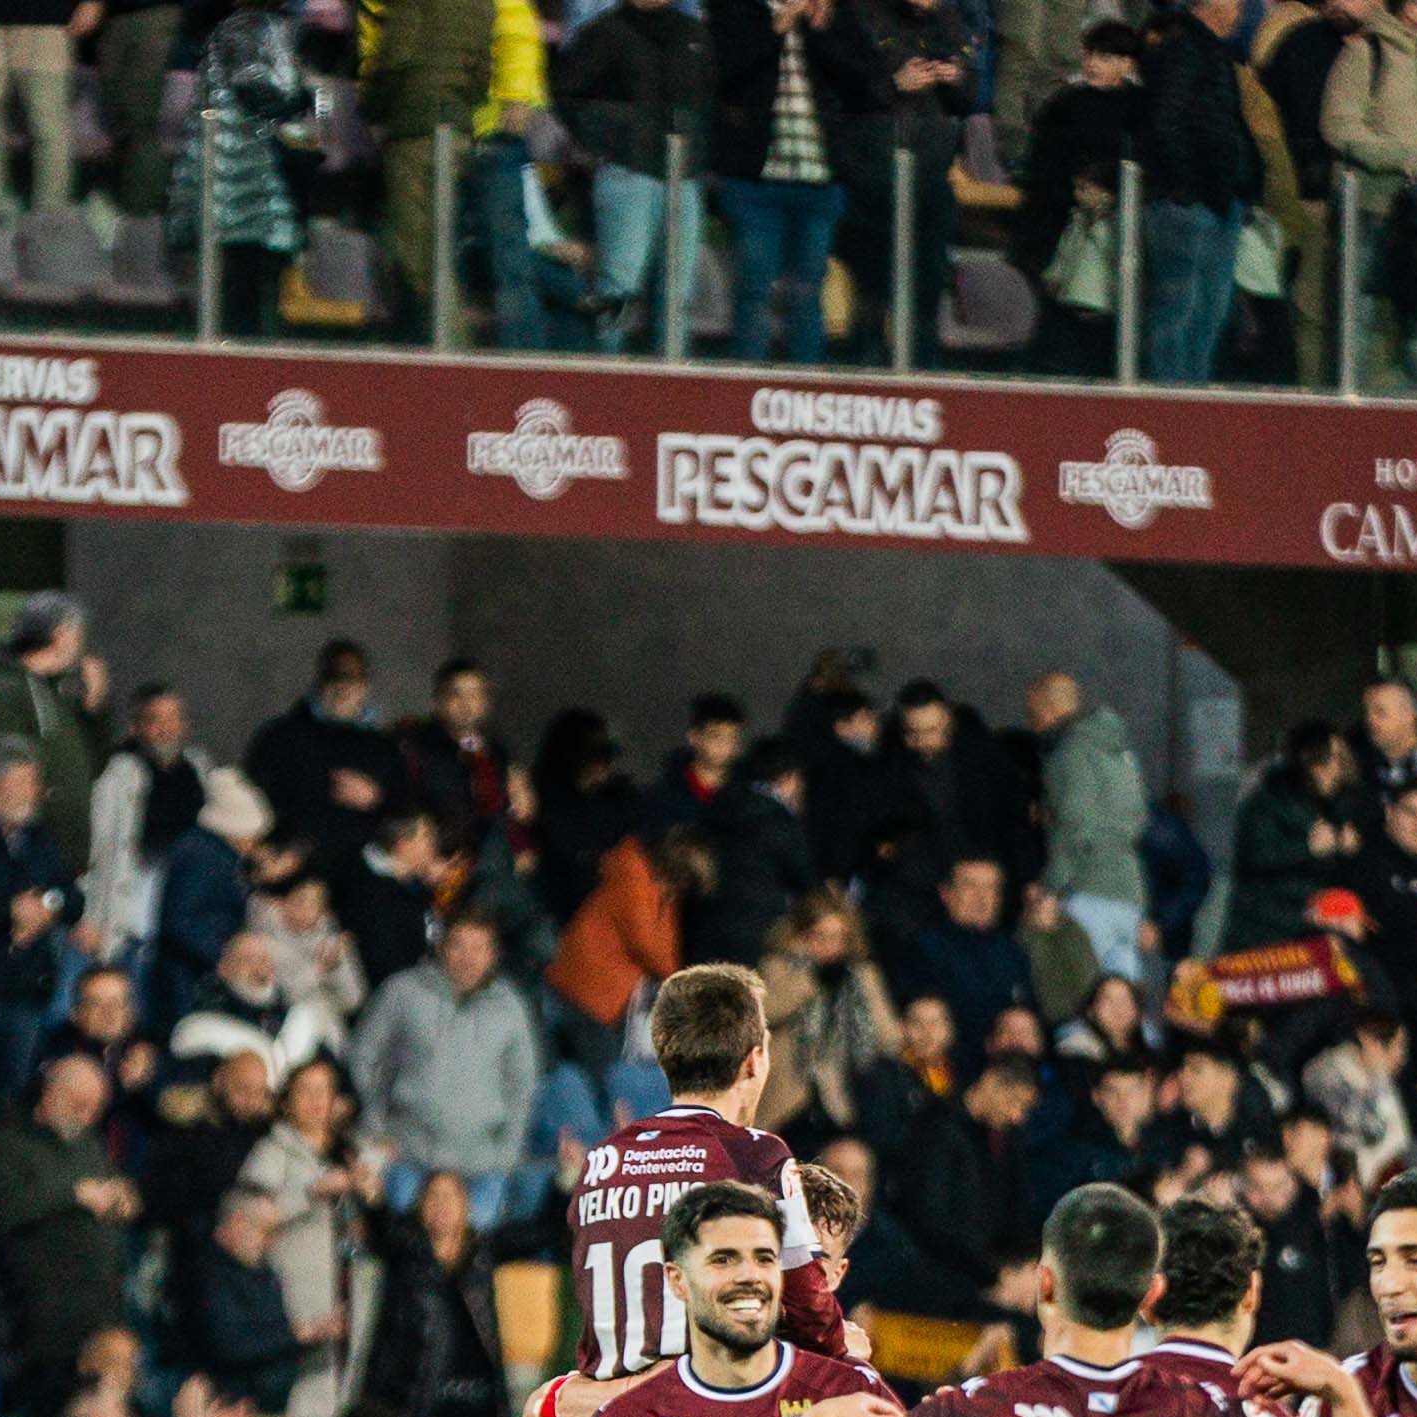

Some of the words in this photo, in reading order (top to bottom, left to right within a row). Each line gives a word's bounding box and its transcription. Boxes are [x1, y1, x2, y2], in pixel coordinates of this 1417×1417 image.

[750, 387, 943, 442] CONSERVAS
[656, 432, 1029, 543] PESCAMAR
[1059, 461, 1214, 509] PESCAMAR
[622, 1160, 704, 1175] Pontevedra
[624, 1145, 707, 1163] Deputación
[578, 1185, 641, 1227] YELKO
[645, 1181, 707, 1217] PIN
[584, 1239, 687, 1381] 10
